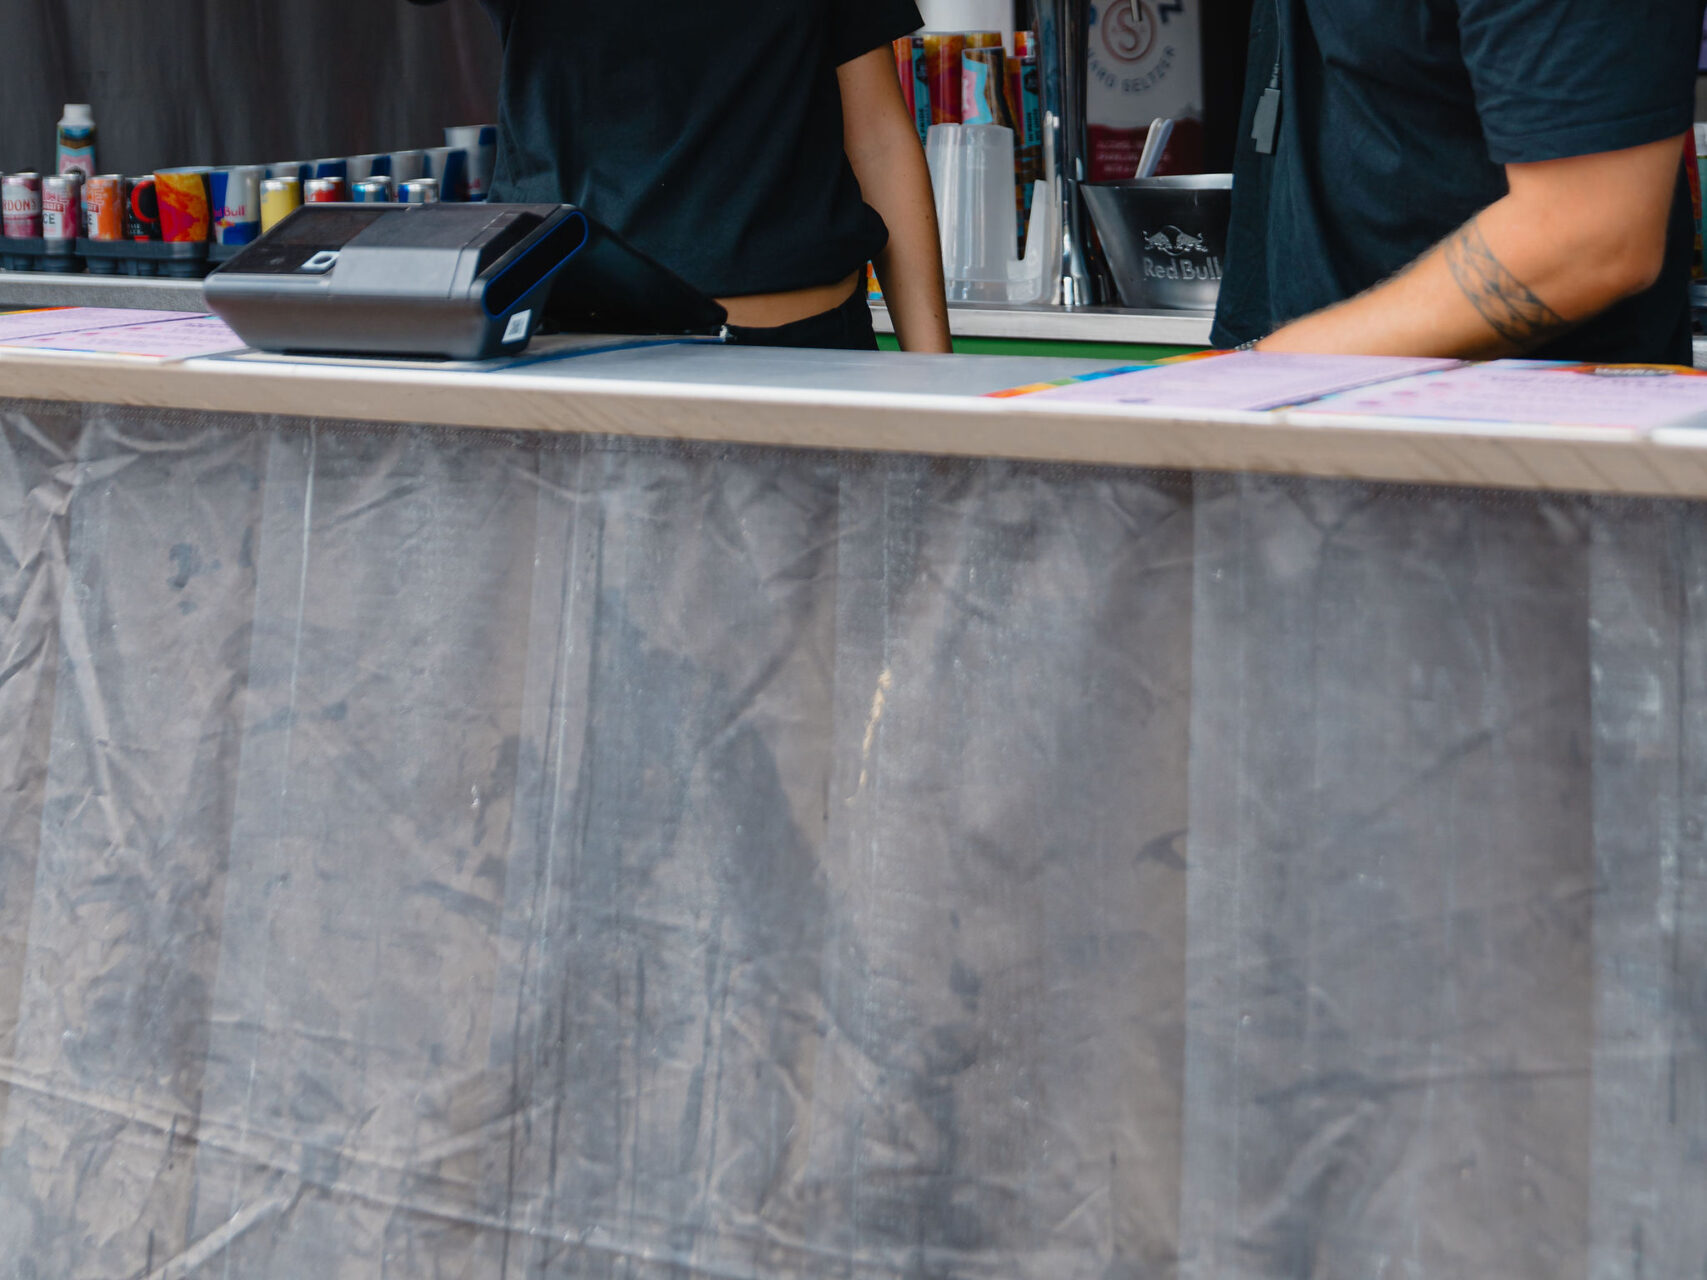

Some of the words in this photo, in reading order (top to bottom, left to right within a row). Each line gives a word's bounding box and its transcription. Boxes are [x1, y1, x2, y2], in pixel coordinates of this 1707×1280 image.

[224, 205, 245, 217] Bull
[1143, 257, 1178, 280] Red
[1181, 256, 1222, 280] Bull
